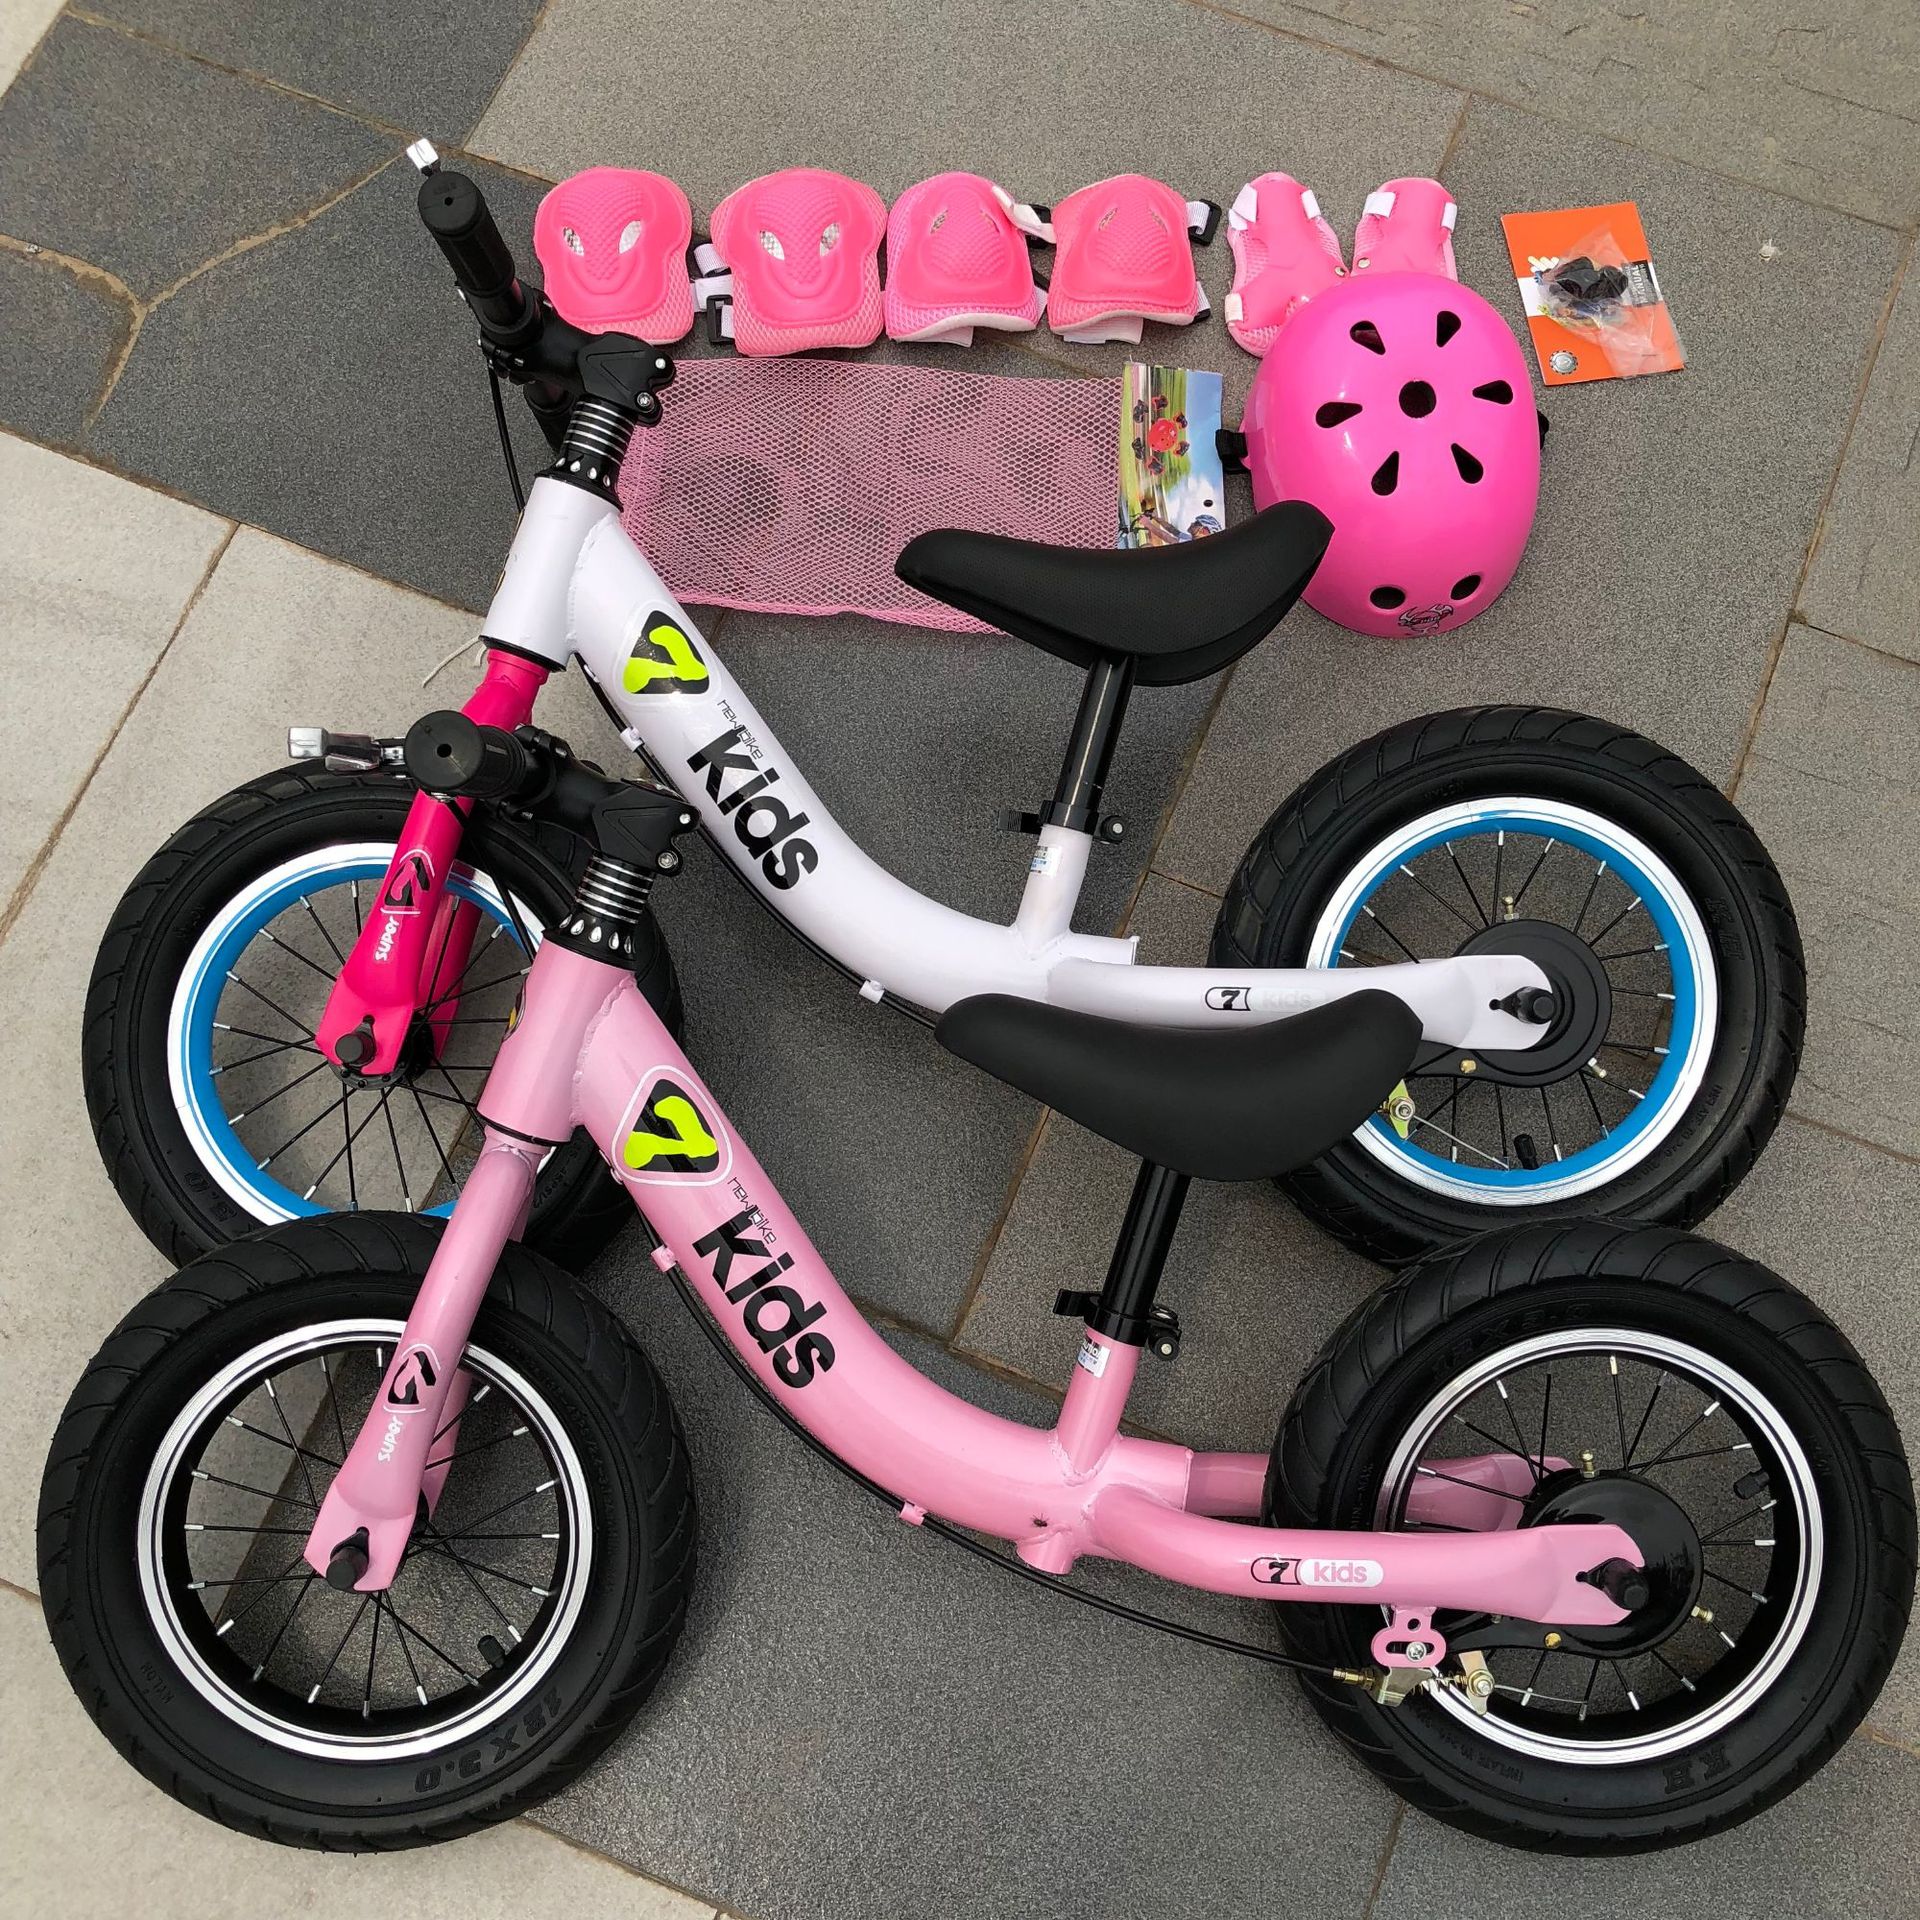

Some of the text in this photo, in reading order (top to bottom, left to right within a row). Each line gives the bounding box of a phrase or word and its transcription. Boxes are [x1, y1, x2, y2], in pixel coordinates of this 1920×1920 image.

[687, 726, 819, 890] kids
[1221, 990, 1240, 1010] 7
[692, 1204, 835, 1388] kids
[1268, 1561, 1367, 1583] 7 kids
